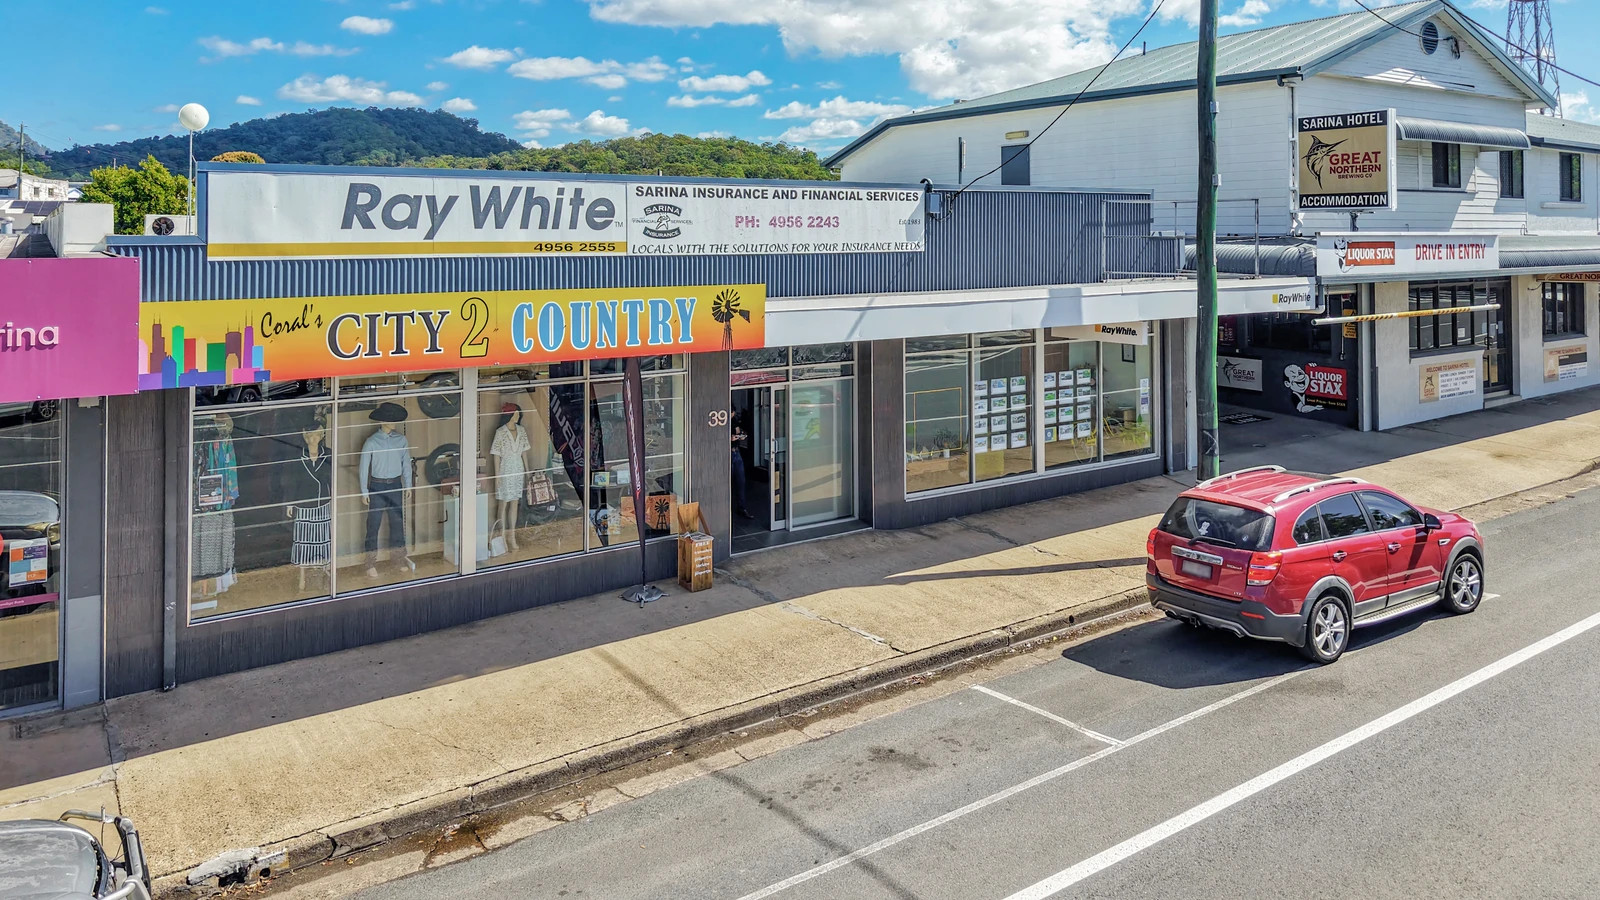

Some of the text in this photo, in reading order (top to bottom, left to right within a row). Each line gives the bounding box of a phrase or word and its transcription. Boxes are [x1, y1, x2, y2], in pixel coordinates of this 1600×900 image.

[1302, 112, 1383, 130] SARINA HOTEL
[1329, 151, 1381, 165] GREAT
[1329, 164, 1381, 174] NORTHERN
[635, 186, 919, 202] SARINA INSURANCE AND FINANCIAL SERVICES
[1301, 194, 1387, 206] ACCOMMODATION
[340, 182, 460, 240] Ray
[469, 185, 616, 230] White
[645, 205, 681, 216] SARINA
[735, 216, 840, 228] PH: 4956 2243
[645, 229, 681, 238] INSURANCE
[533, 243, 616, 252] 4956 2555
[632, 242, 920, 254] LOCALS WITH THE SOLUTIONS FOR YOUR INSURANCE NEEDS
[1416, 243, 1486, 260] DRIVE IN ENTRY
[1348, 248, 1394, 262] LIQUOR STAX
[260, 297, 697, 360] Coral's CITY 2 COUNTRY
[1310, 371, 1342, 382] LIQUOR
[1310, 380, 1343, 396] STAX
[708, 410, 728, 427] 39
